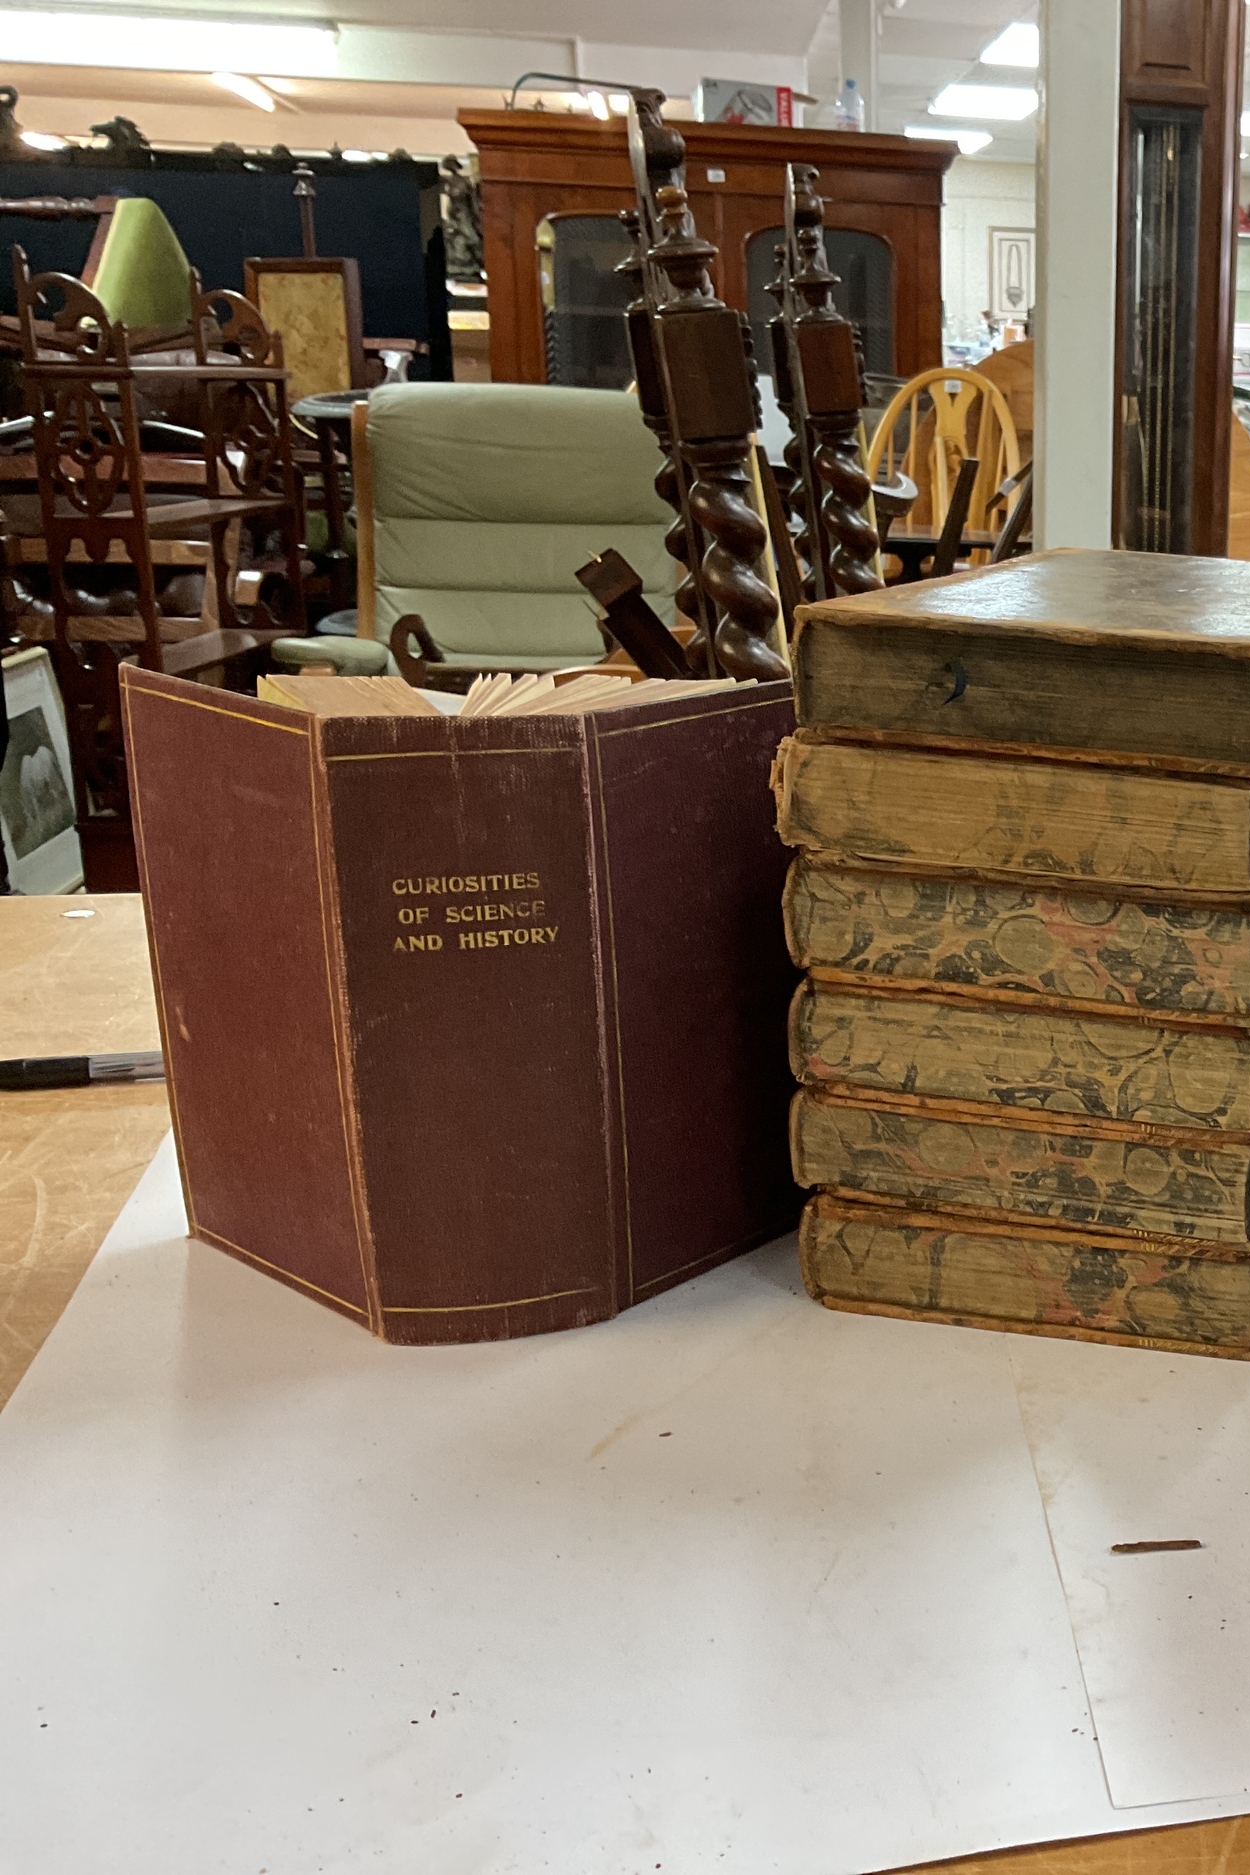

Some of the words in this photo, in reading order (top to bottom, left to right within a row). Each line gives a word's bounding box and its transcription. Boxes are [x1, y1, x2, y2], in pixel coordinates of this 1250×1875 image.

[392, 872, 541, 895] CURIOSITIES
[398, 907, 429, 925] OF
[445, 900, 546, 923] SCIENCE
[393, 934, 443, 952] AND
[458, 926, 559, 950] HISTORY
